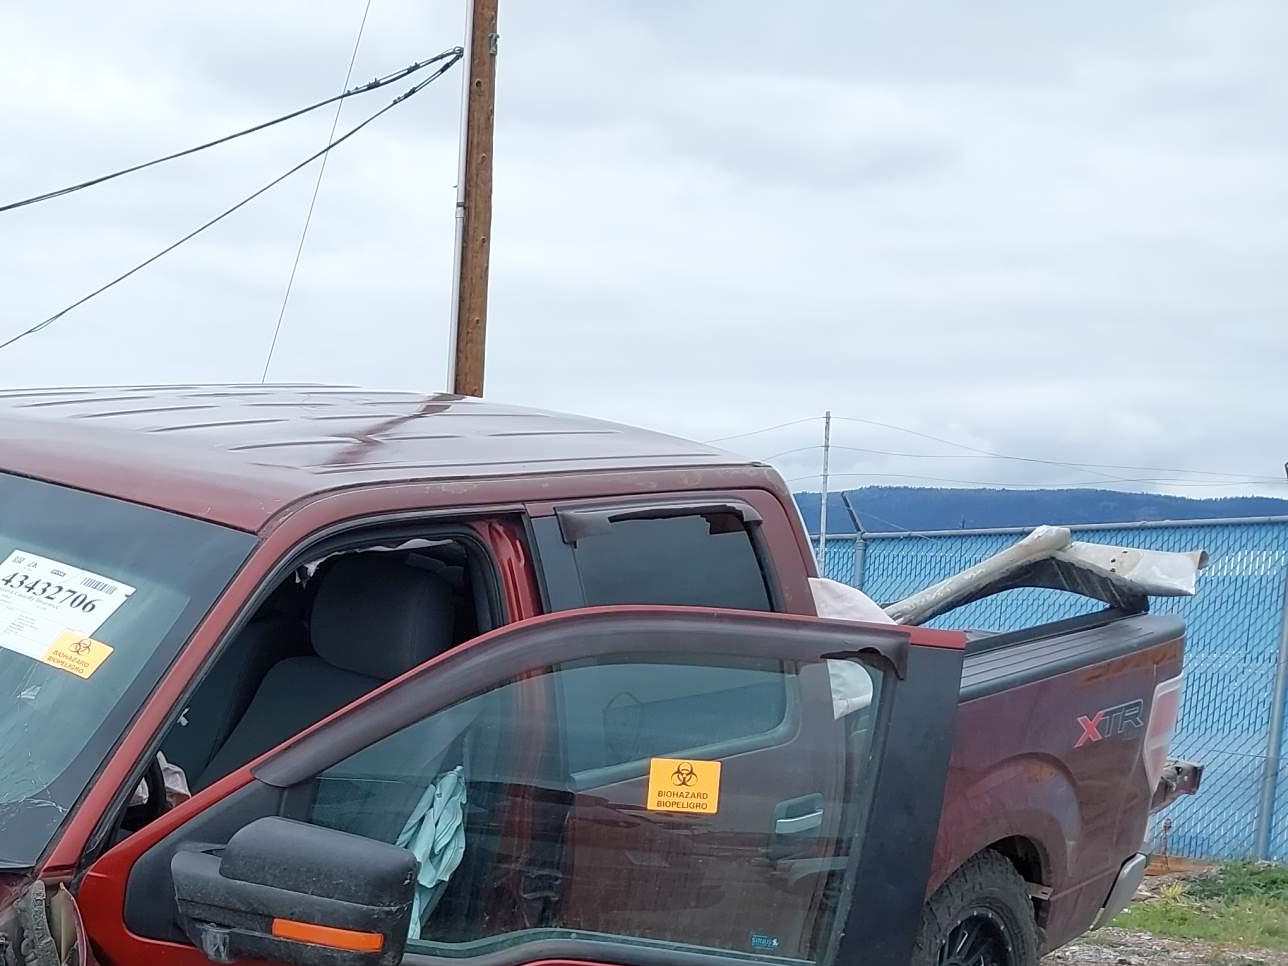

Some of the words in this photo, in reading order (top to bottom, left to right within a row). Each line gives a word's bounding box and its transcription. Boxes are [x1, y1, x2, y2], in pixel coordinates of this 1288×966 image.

[1, 571, 103, 614] 43432706
[52, 650, 90, 667] BIOHAZARD
[1073, 698, 1144, 748] XTR
[657, 790, 709, 800] BIOHAZARD
[656, 800, 708, 810] BIOPELIGRO
